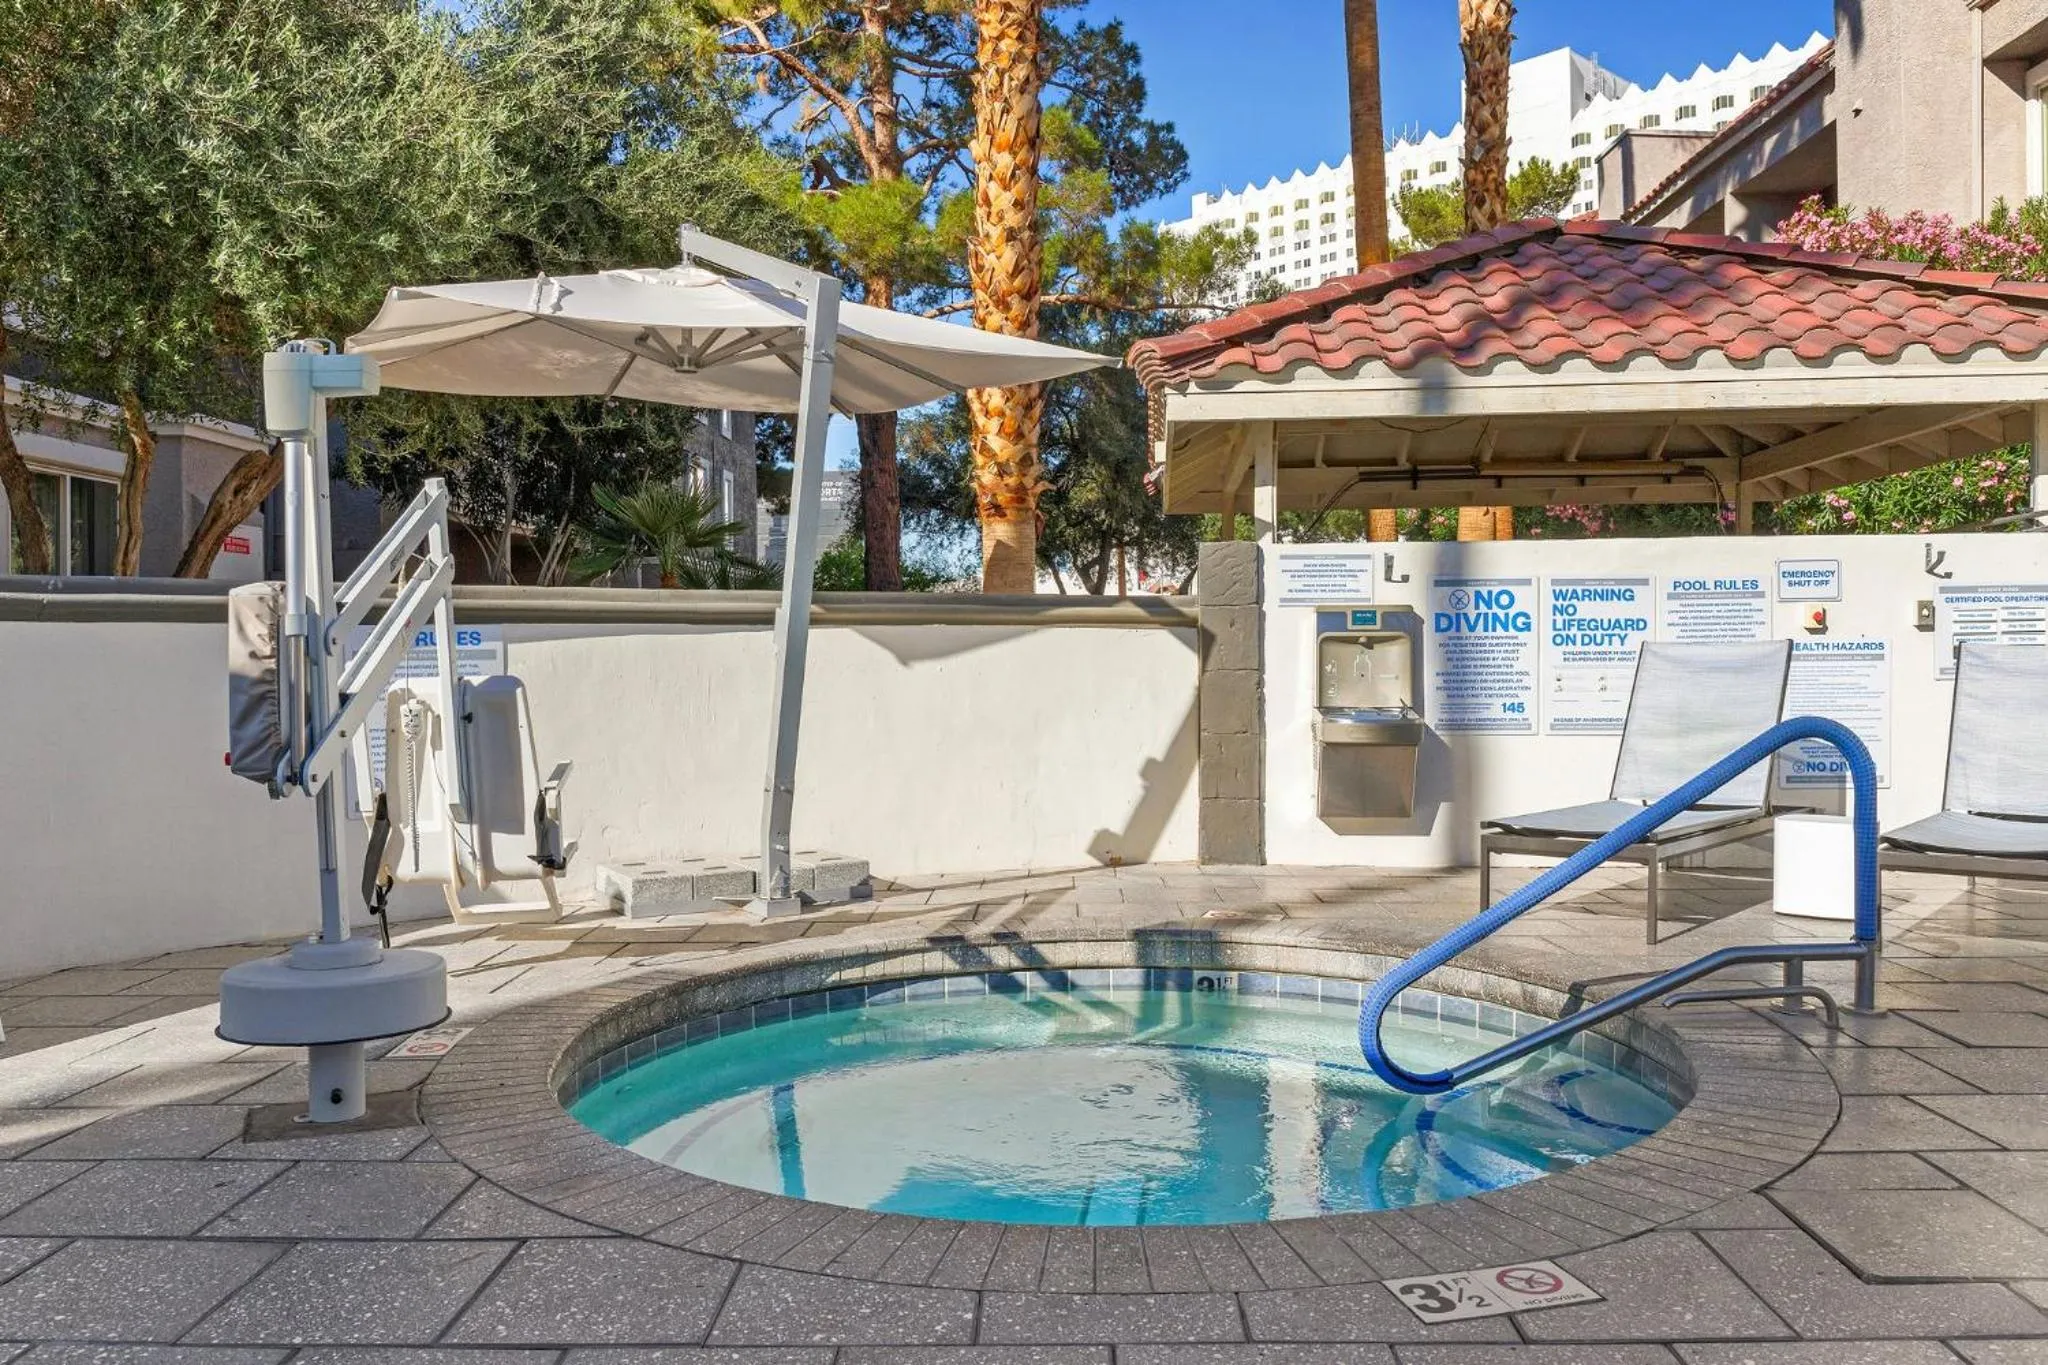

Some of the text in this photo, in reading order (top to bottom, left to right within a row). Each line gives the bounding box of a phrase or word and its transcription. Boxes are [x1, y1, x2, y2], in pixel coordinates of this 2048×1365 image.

[1782, 570, 1835, 578] EMERGENCY
[1674, 580, 1759, 591] POOL RULES
[1474, 589, 1515, 610] NO
[1552, 589, 1635, 602] WARNING
[1552, 604, 1577, 616] NO
[1434, 612, 1532, 633] DIVING
[1552, 618, 1647, 631] LIFEGUARD
[415, 631, 481, 646] RUES
[1552, 633, 1628, 646] ON DUTY
[1832, 642, 1885, 651] HAZARDS
[1501, 702, 1525, 713] 145
[1806, 761, 1825, 772] NO
[1523, 1293, 1585, 1306] NO DIVING
